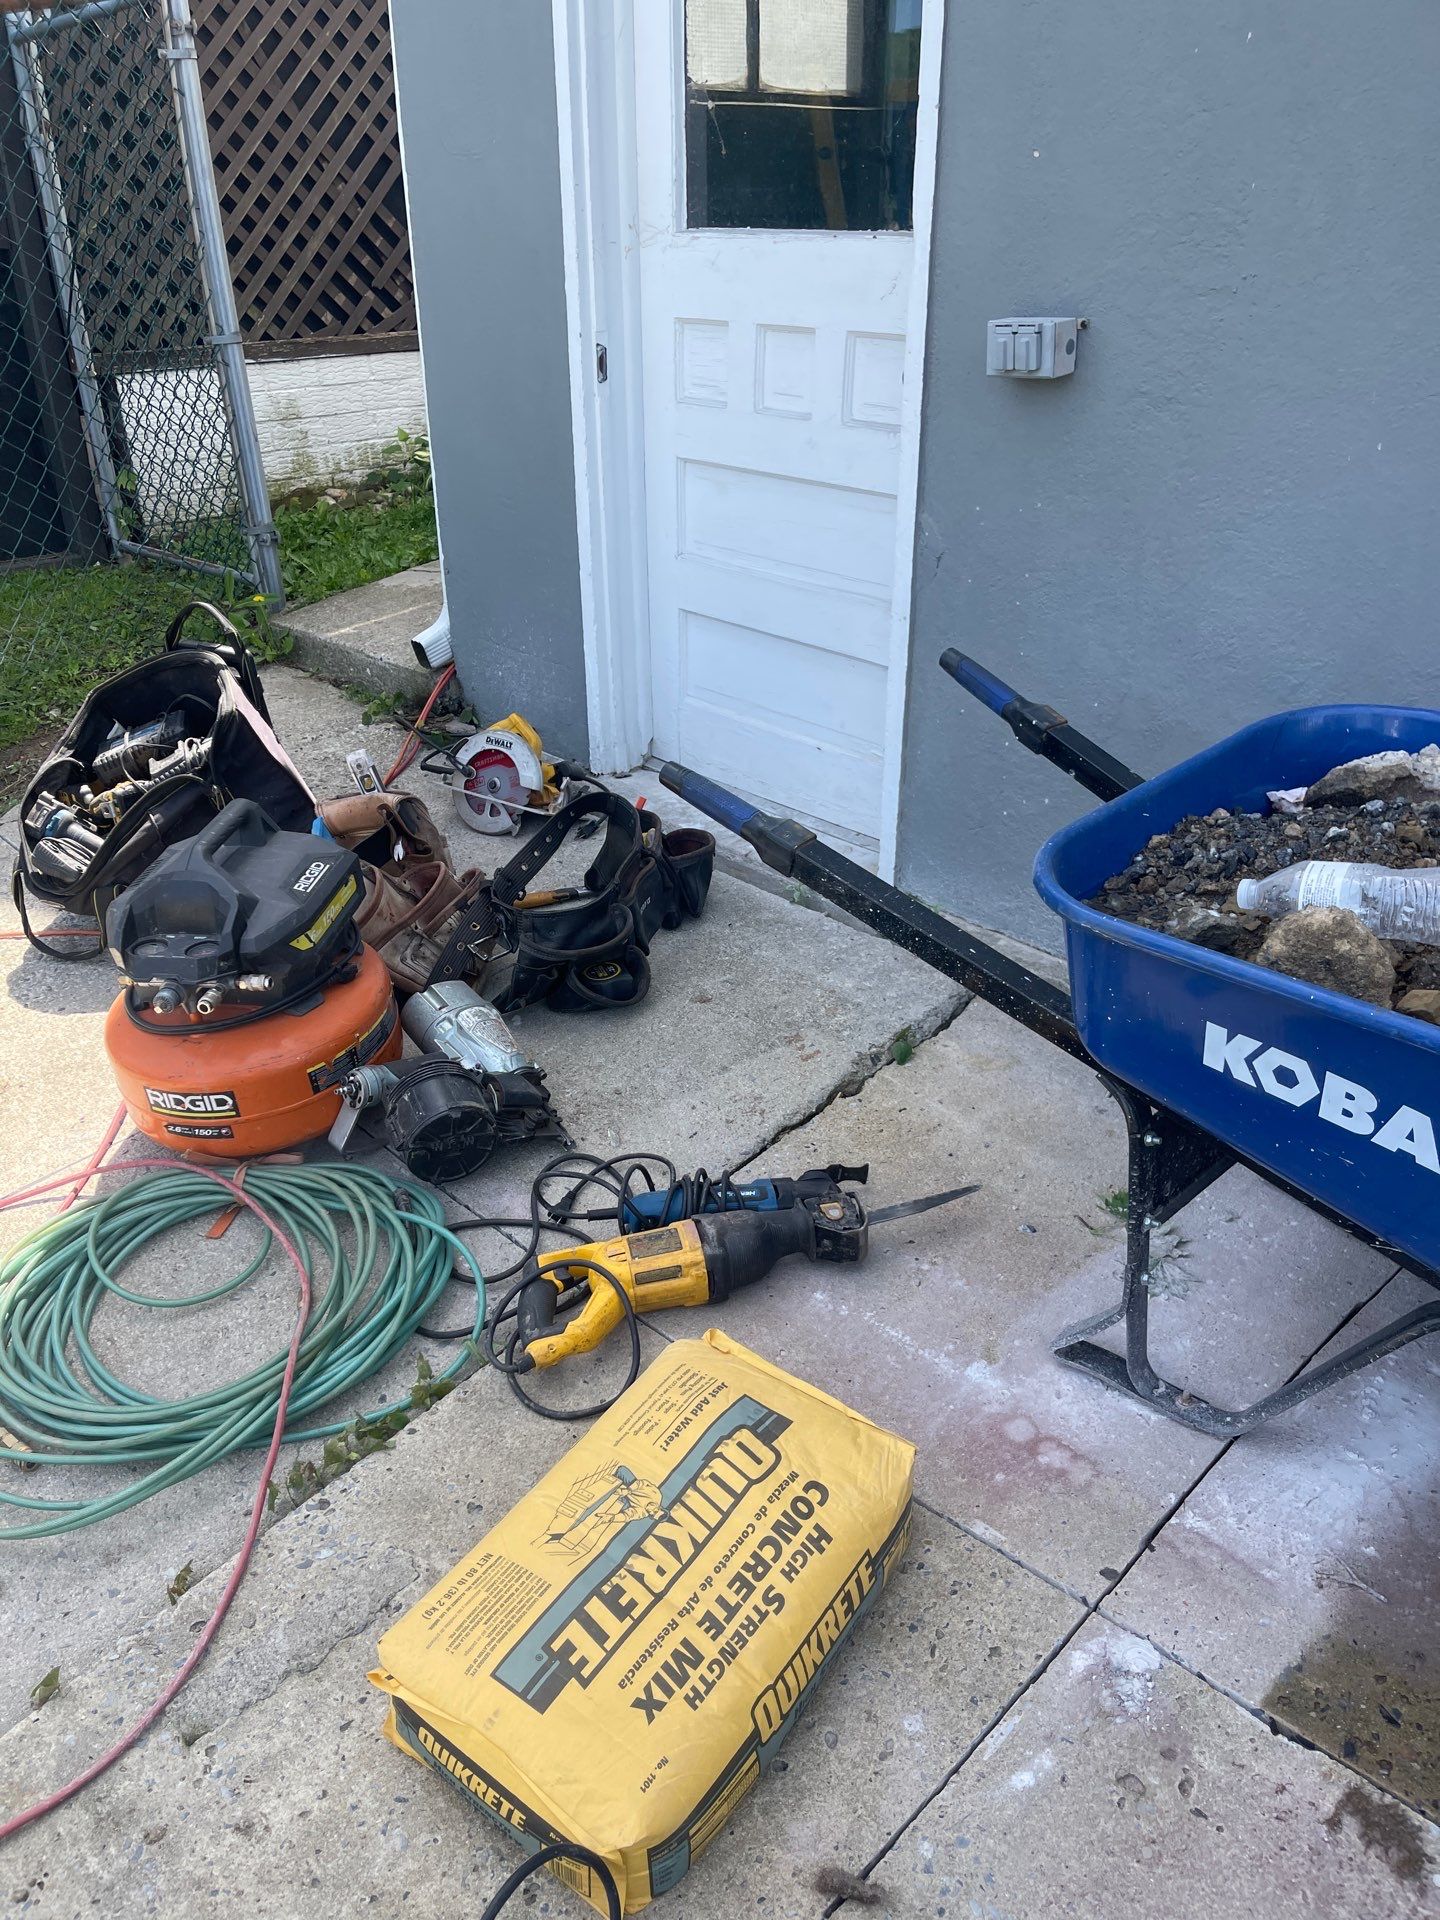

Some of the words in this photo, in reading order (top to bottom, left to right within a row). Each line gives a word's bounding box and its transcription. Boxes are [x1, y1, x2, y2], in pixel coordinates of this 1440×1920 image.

[293, 862, 324, 891] RIDGID
[145, 1088, 233, 1111] RIDGID
[1203, 1021, 1440, 1175] KOBA
[708, 1382, 728, 1398] Just
[690, 1397, 710, 1416] Add
[660, 1417, 692, 1452] Water!
[767, 1471, 799, 1504] Mezcla
[754, 1506, 767, 1521] de
[476, 1553, 494, 1568] NET
[549, 1426, 775, 1678] QUIKRETE
[696, 1480, 829, 1642] CONCRETE
[714, 1523, 755, 1574] Concreto
[780, 1523, 833, 1583] HIGH
[466, 1568, 478, 1577] 80
[699, 1576, 713, 1591] de
[436, 1586, 458, 1606] (36.2
[677, 1592, 700, 1618] Alta
[422, 1607, 438, 1619] kg)
[618, 1618, 679, 1689] Resistencia
[683, 1584, 785, 1711] STRENGTH
[754, 1553, 875, 1744] QUIKRETE
[630, 1637, 705, 1726] MIX
[655, 1756, 668, 1770] No.
[418, 1726, 526, 1831] QUIKRETE
[640, 1773, 656, 1793] 1101
